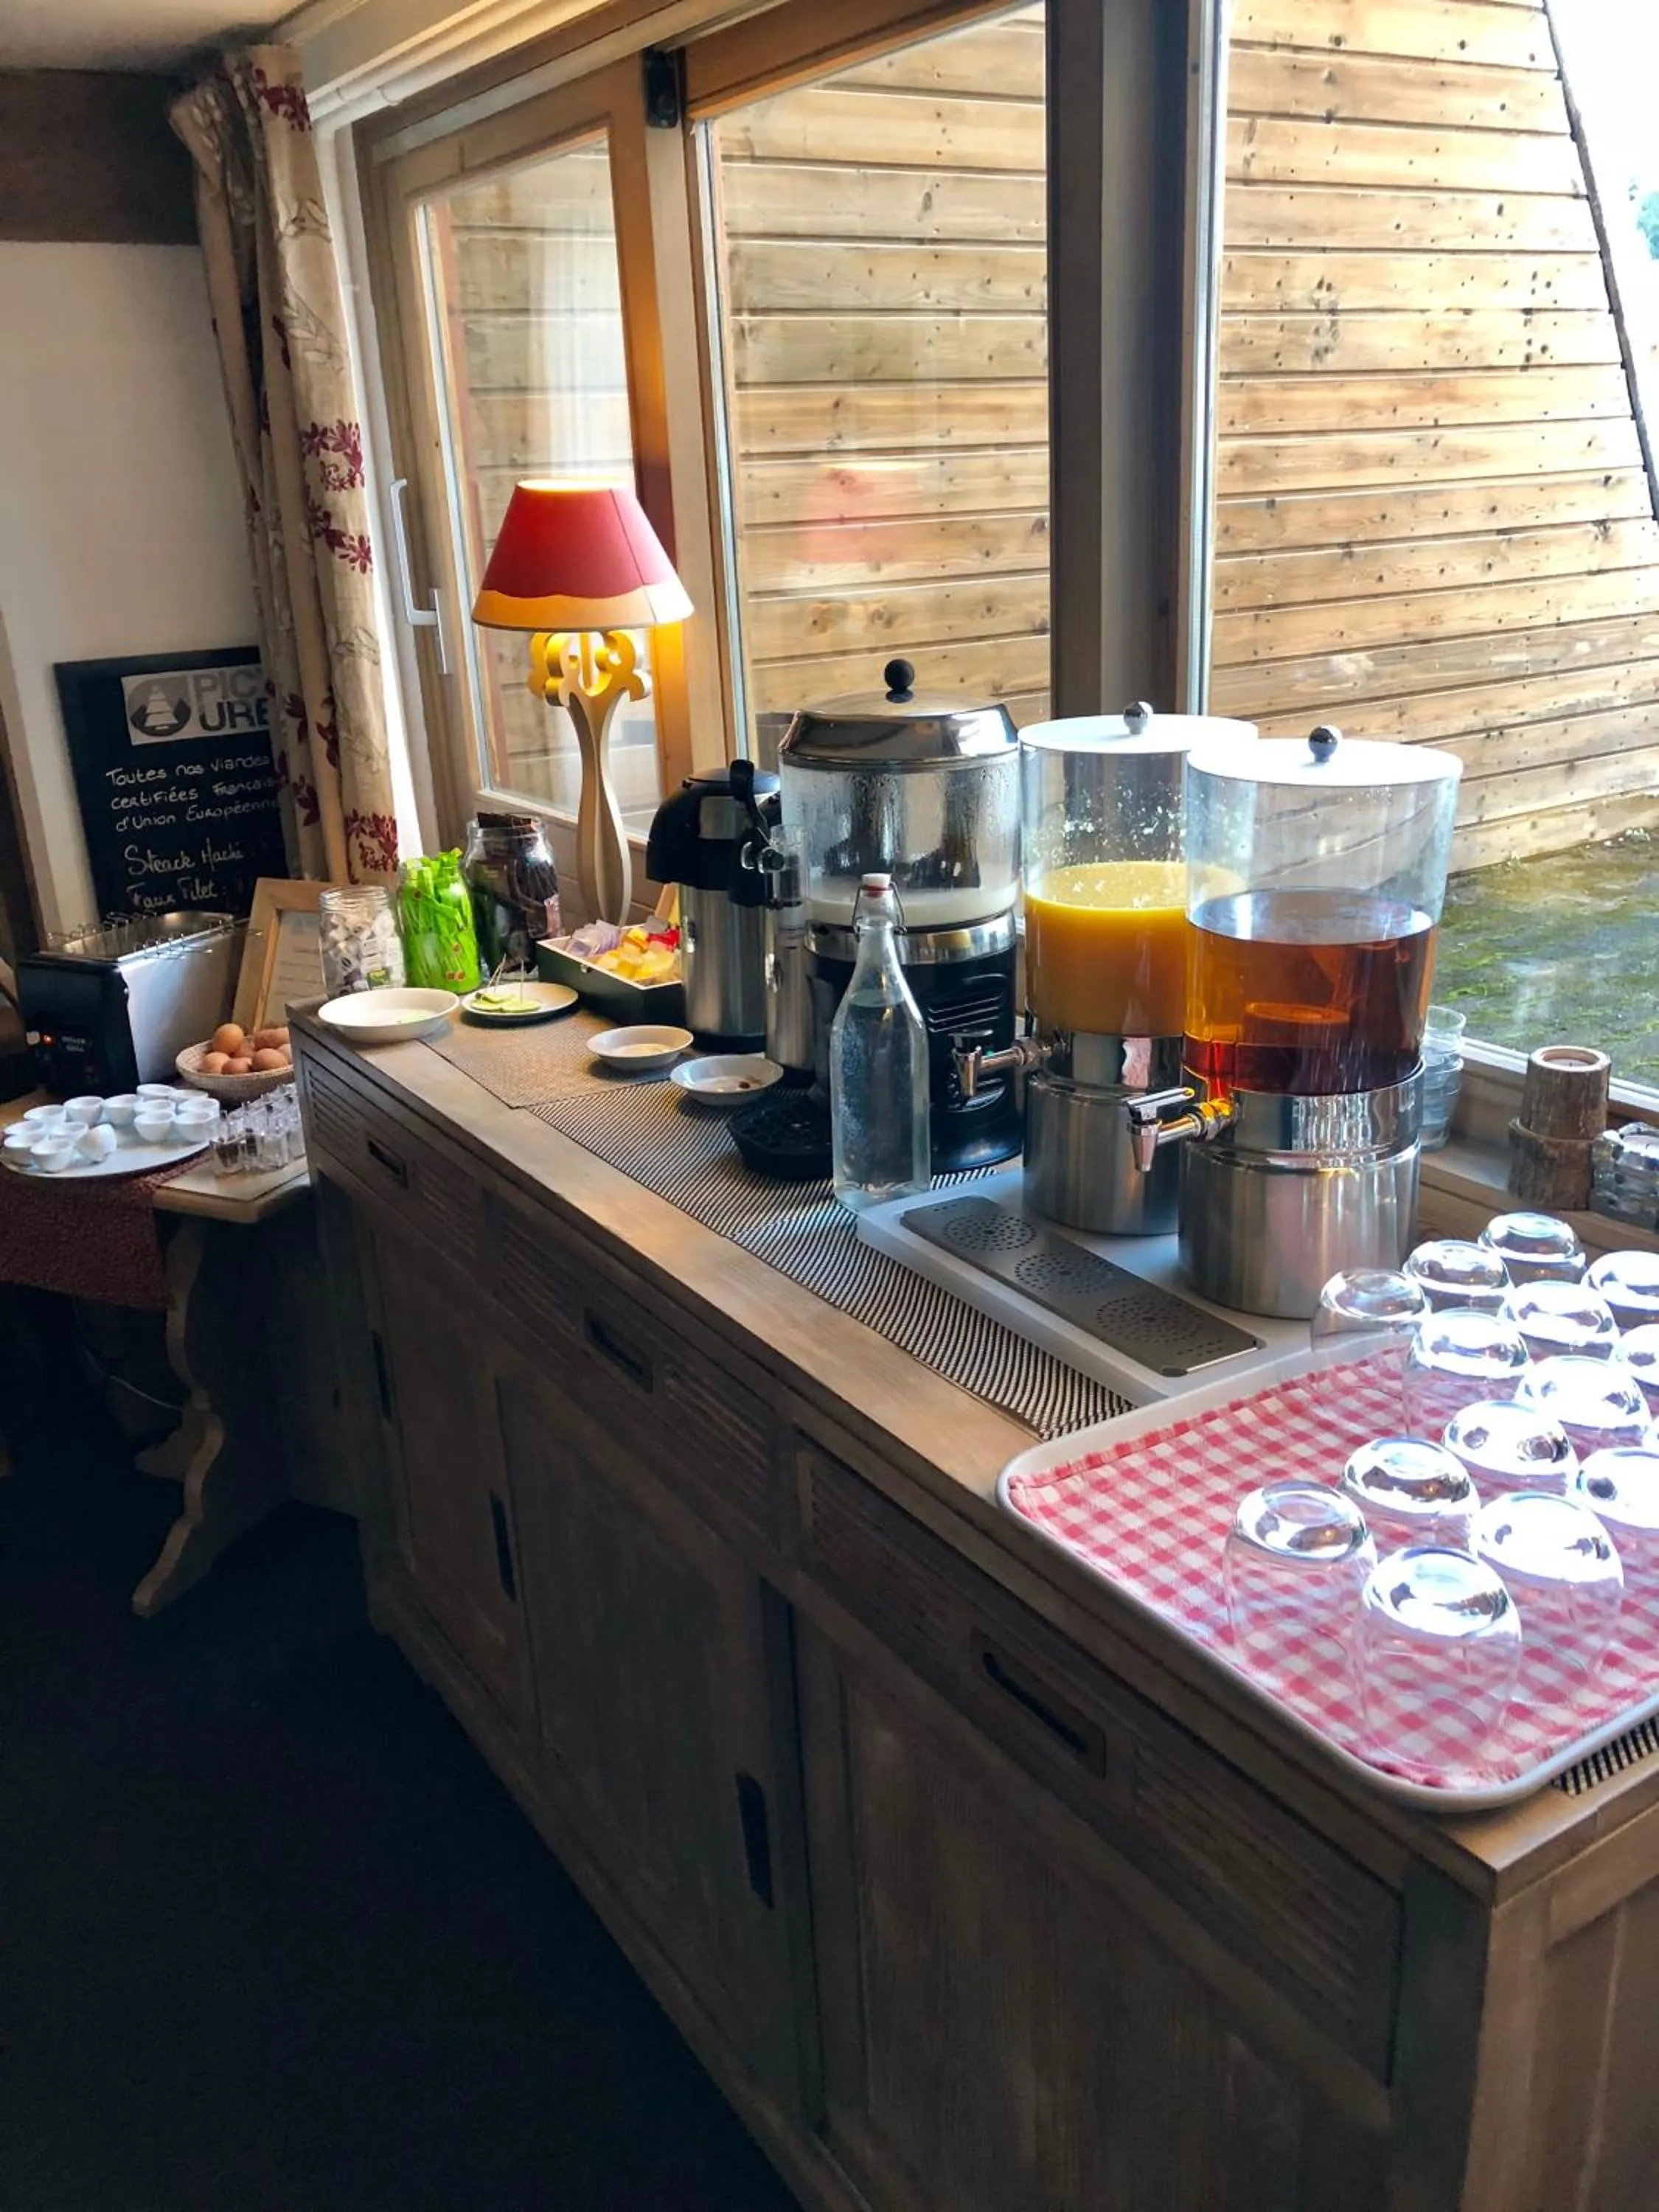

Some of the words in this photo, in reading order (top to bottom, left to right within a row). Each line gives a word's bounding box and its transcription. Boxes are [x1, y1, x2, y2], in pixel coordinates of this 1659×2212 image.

[193, 668, 260, 701] PIC
[106, 767, 167, 787] Toutes
[175, 763, 205, 777] nos
